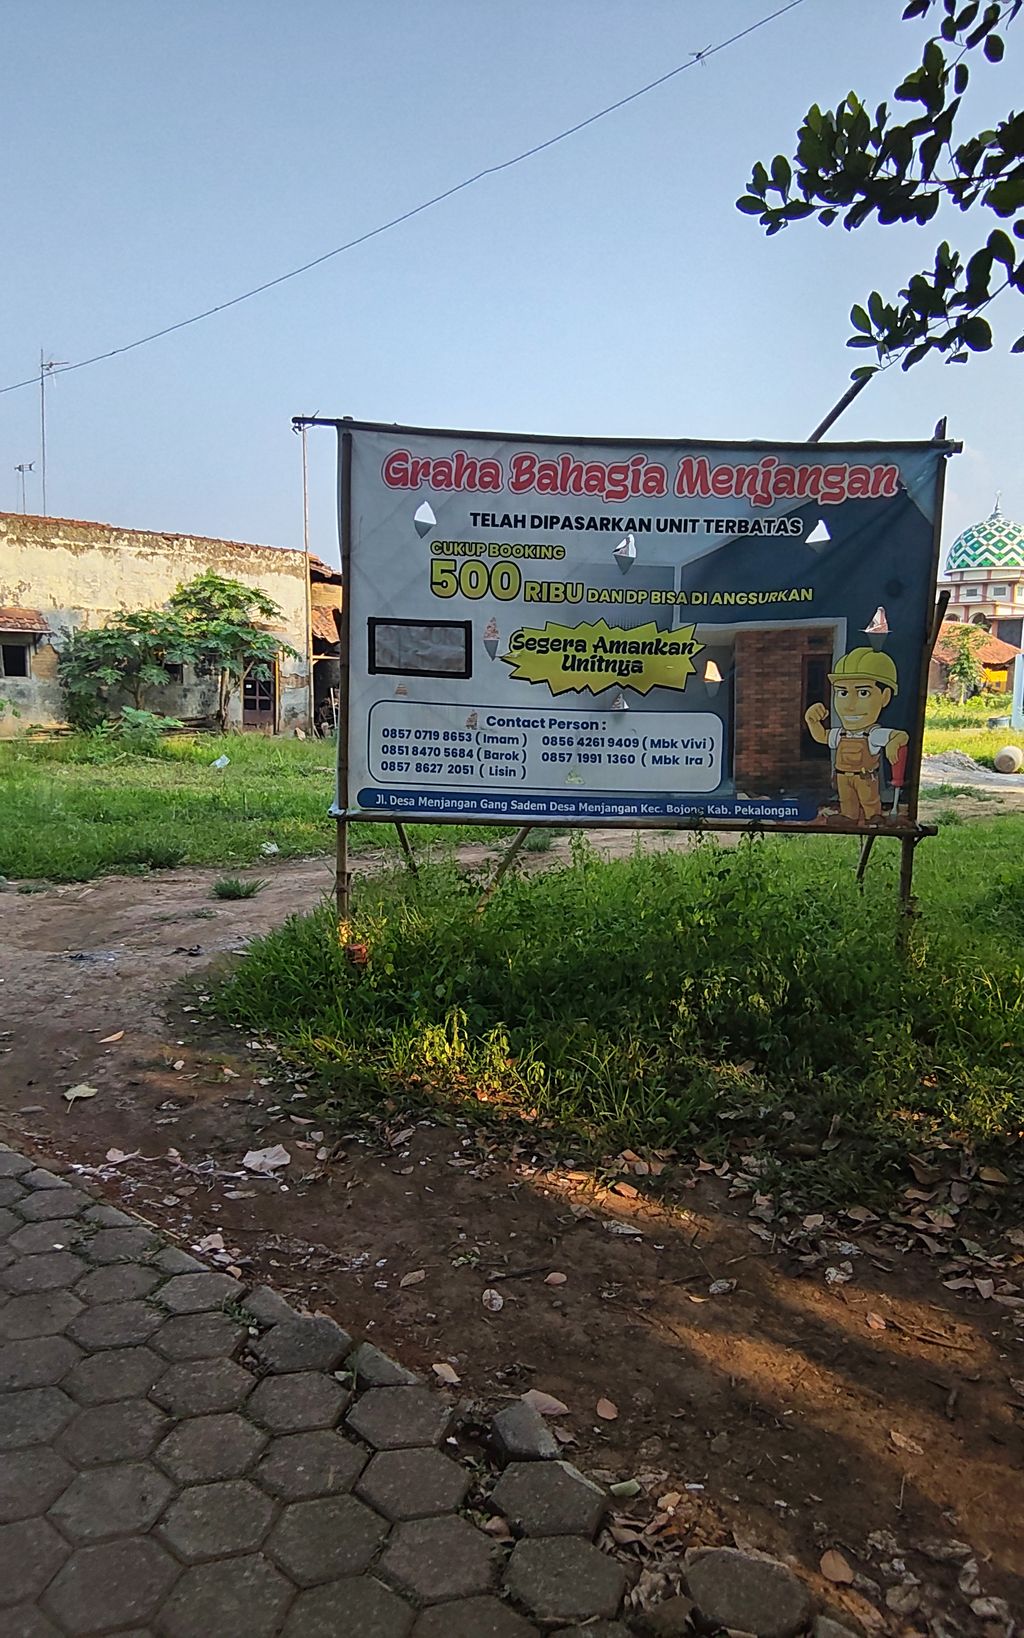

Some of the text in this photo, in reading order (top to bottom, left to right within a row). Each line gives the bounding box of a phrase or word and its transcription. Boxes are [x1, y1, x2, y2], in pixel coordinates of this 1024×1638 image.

[382, 449, 899, 507] Graha Bahagia Menjangan
[470, 512, 803, 535] TELAH DIPASARKAN UNIT TERBATAS
[430, 541, 566, 559] CUKUP BOOKING
[430, 559, 813, 605] 500 RIBU DAN DP BISA DI ANGSURKAN
[512, 634, 695, 656] Segera Amankan
[561, 654, 644, 677] Unitnya
[486, 716, 546, 729] Contact
[382, 728, 411, 739] 0857
[414, 730, 440, 741] 0719
[442, 731, 472, 742] 8653
[542, 736, 574, 746] 0856
[577, 738, 604, 748] 4261
[607, 738, 639, 748] 9409
[381, 745, 409, 756] 0851
[411, 746, 441, 757] 8470
[443, 747, 474, 759] 5684
[541, 752, 573, 763] 0857
[577, 754, 602, 764] 1991
[607, 754, 636, 764] 1360
[380, 761, 411, 772] 0857
[415, 763, 443, 773] 8627
[447, 764, 475, 775] 2051
[390, 795, 415, 806] Desa
[418, 797, 477, 810] Menjangan
[480, 799, 508, 812] Gang
[511, 800, 547, 811] Sadem
[550, 802, 576, 812] Desa
[578, 803, 638, 815] Menjangan
[640, 804, 664, 814] Kec.
[707, 805, 732, 815] Kab.
[734, 805, 799, 818] Pekalongan
